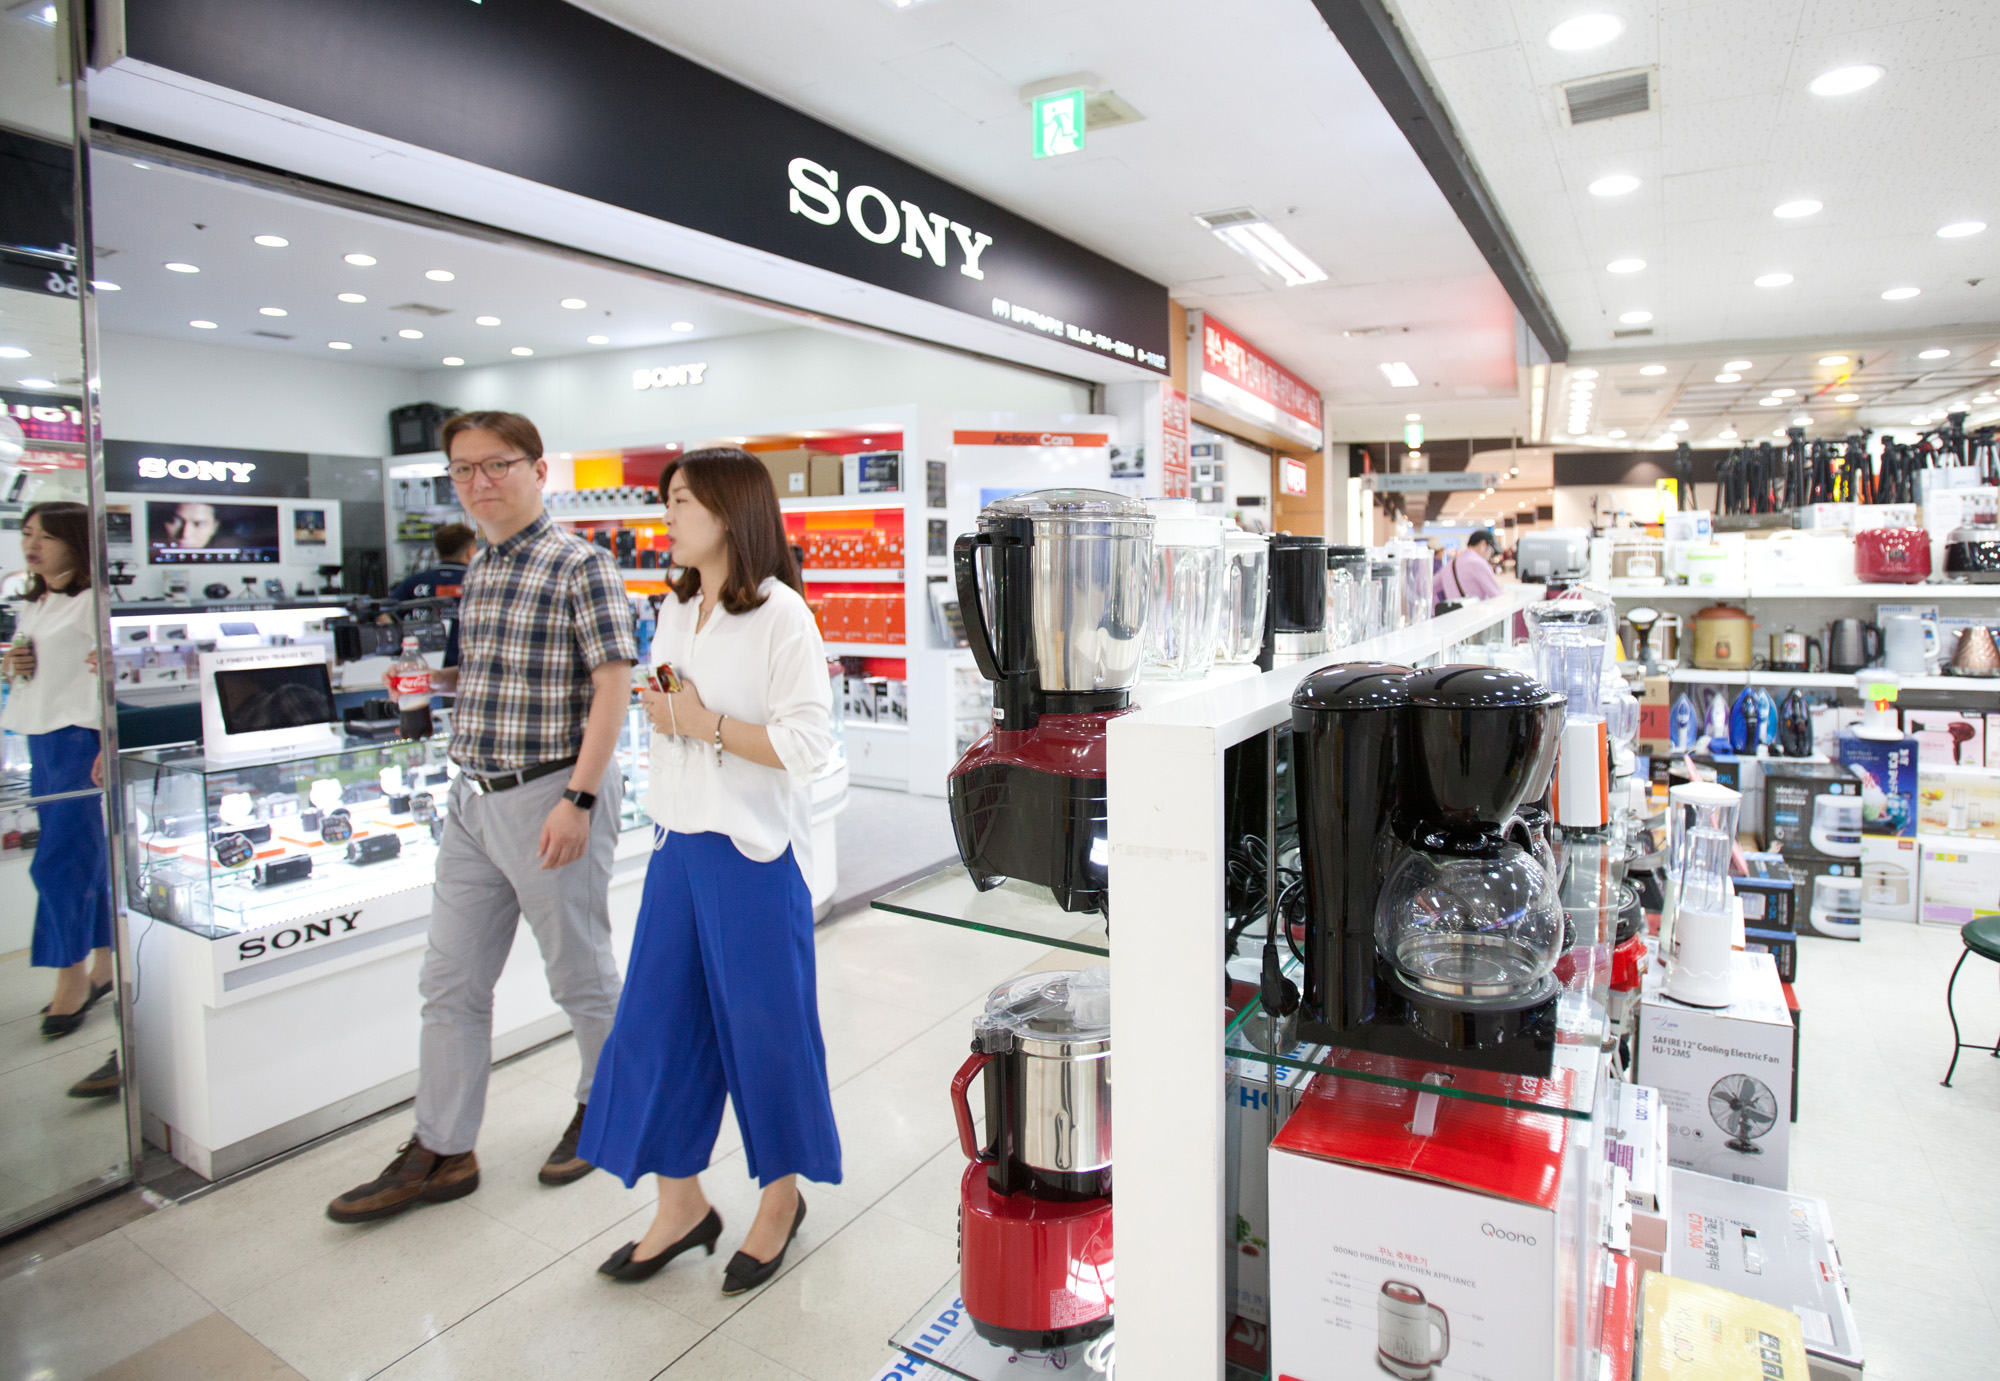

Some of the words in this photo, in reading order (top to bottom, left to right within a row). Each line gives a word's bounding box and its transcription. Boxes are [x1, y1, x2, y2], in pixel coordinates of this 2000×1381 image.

[787, 156, 994, 281] SONY
[632, 361, 708, 391] SONY
[993, 432, 1037, 446] Action
[1039, 433, 1074, 447] Cam
[137, 457, 257, 484] SONY
[238, 910, 363, 960] SONY
[1652, 1035, 1682, 1048] SAFIRE
[1697, 1043, 1730, 1057] Cooling
[1730, 1048, 1762, 1061] Electric
[1763, 1053, 1780, 1064] Fan
[1652, 1046, 1692, 1059] HJ-12MS
[1481, 1222, 1537, 1247] Qoono
[1688, 1213, 1704, 1250] CTM-304
[1333, 1245, 1359, 1258] QOONO
[1360, 1252, 1397, 1268] PORRIDGE
[1398, 1262, 1432, 1277] KITCHEN
[1433, 1271, 1477, 1289] APPLIANCE
